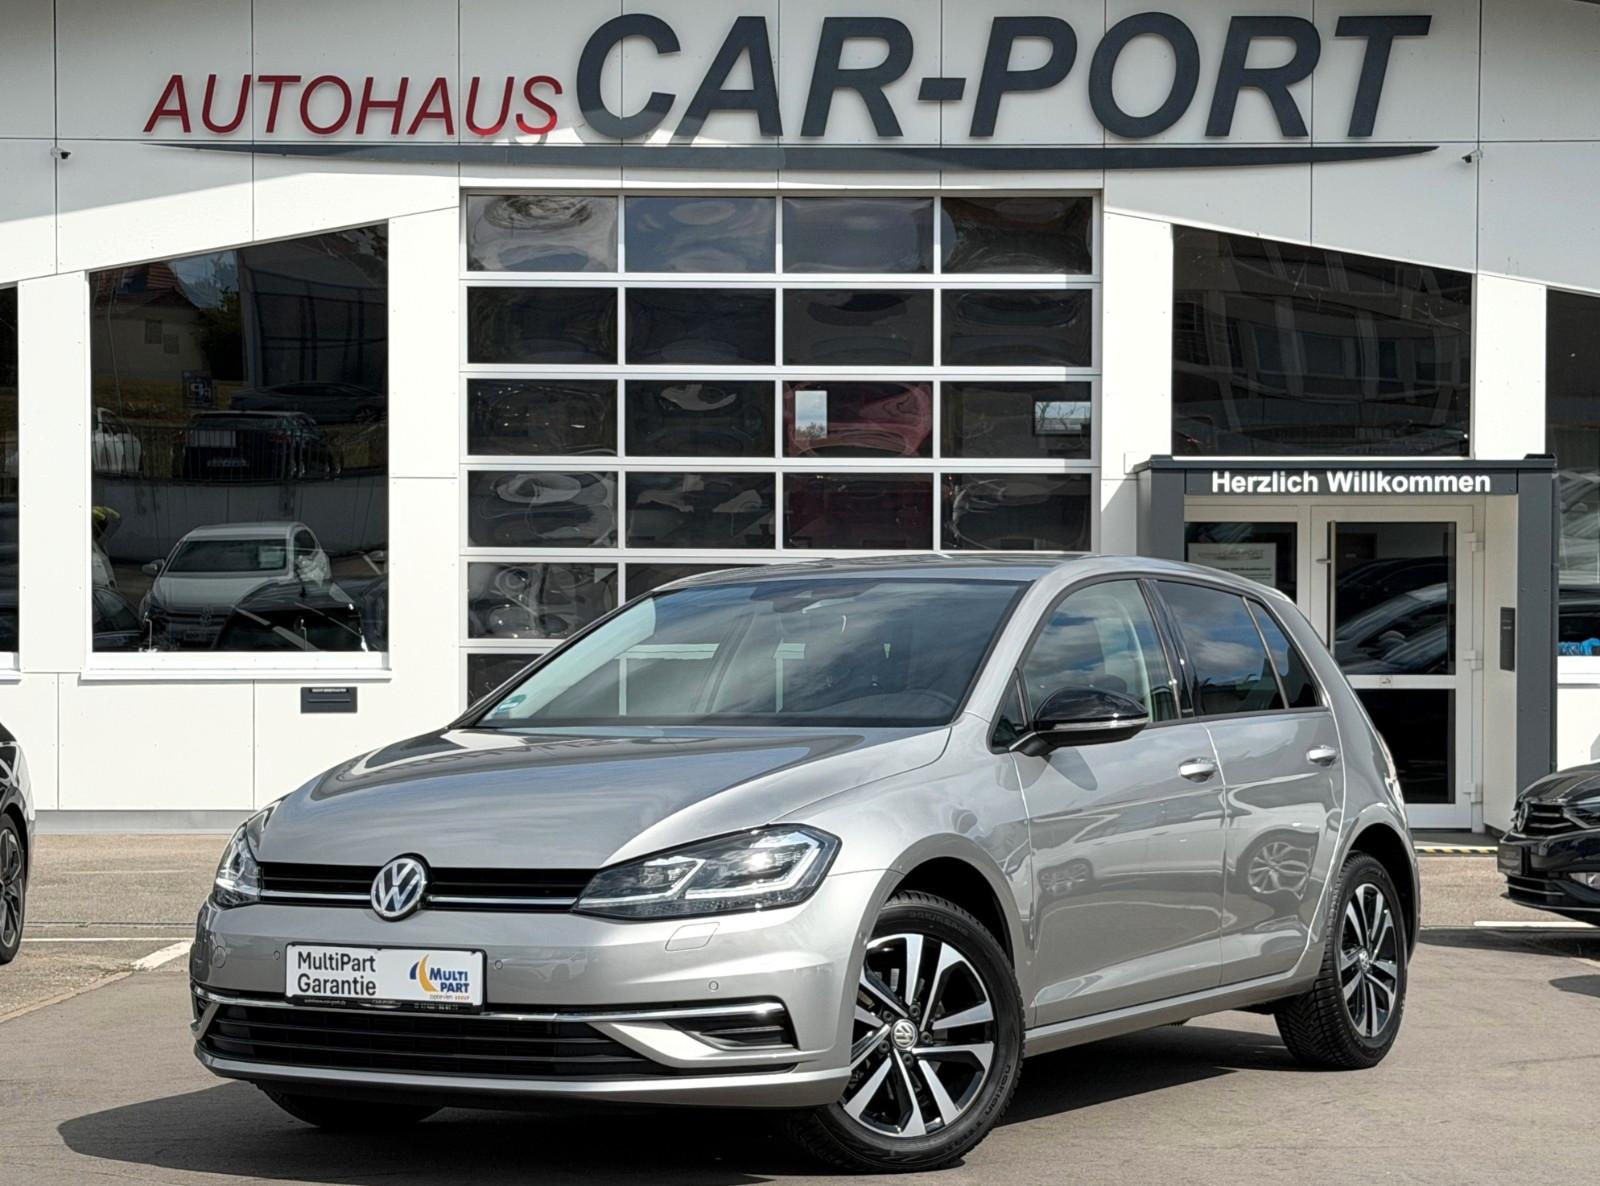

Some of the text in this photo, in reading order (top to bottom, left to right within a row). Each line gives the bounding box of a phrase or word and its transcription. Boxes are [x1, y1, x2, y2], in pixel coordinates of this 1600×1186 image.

[143, 11, 1432, 140] AUTOHAUS CAR-PORT
[1211, 471, 1492, 493] Herzlich Willkommen
[297, 951, 377, 973] MultiPart
[297, 972, 377, 997] Garantie
[440, 982, 470, 994] PART
